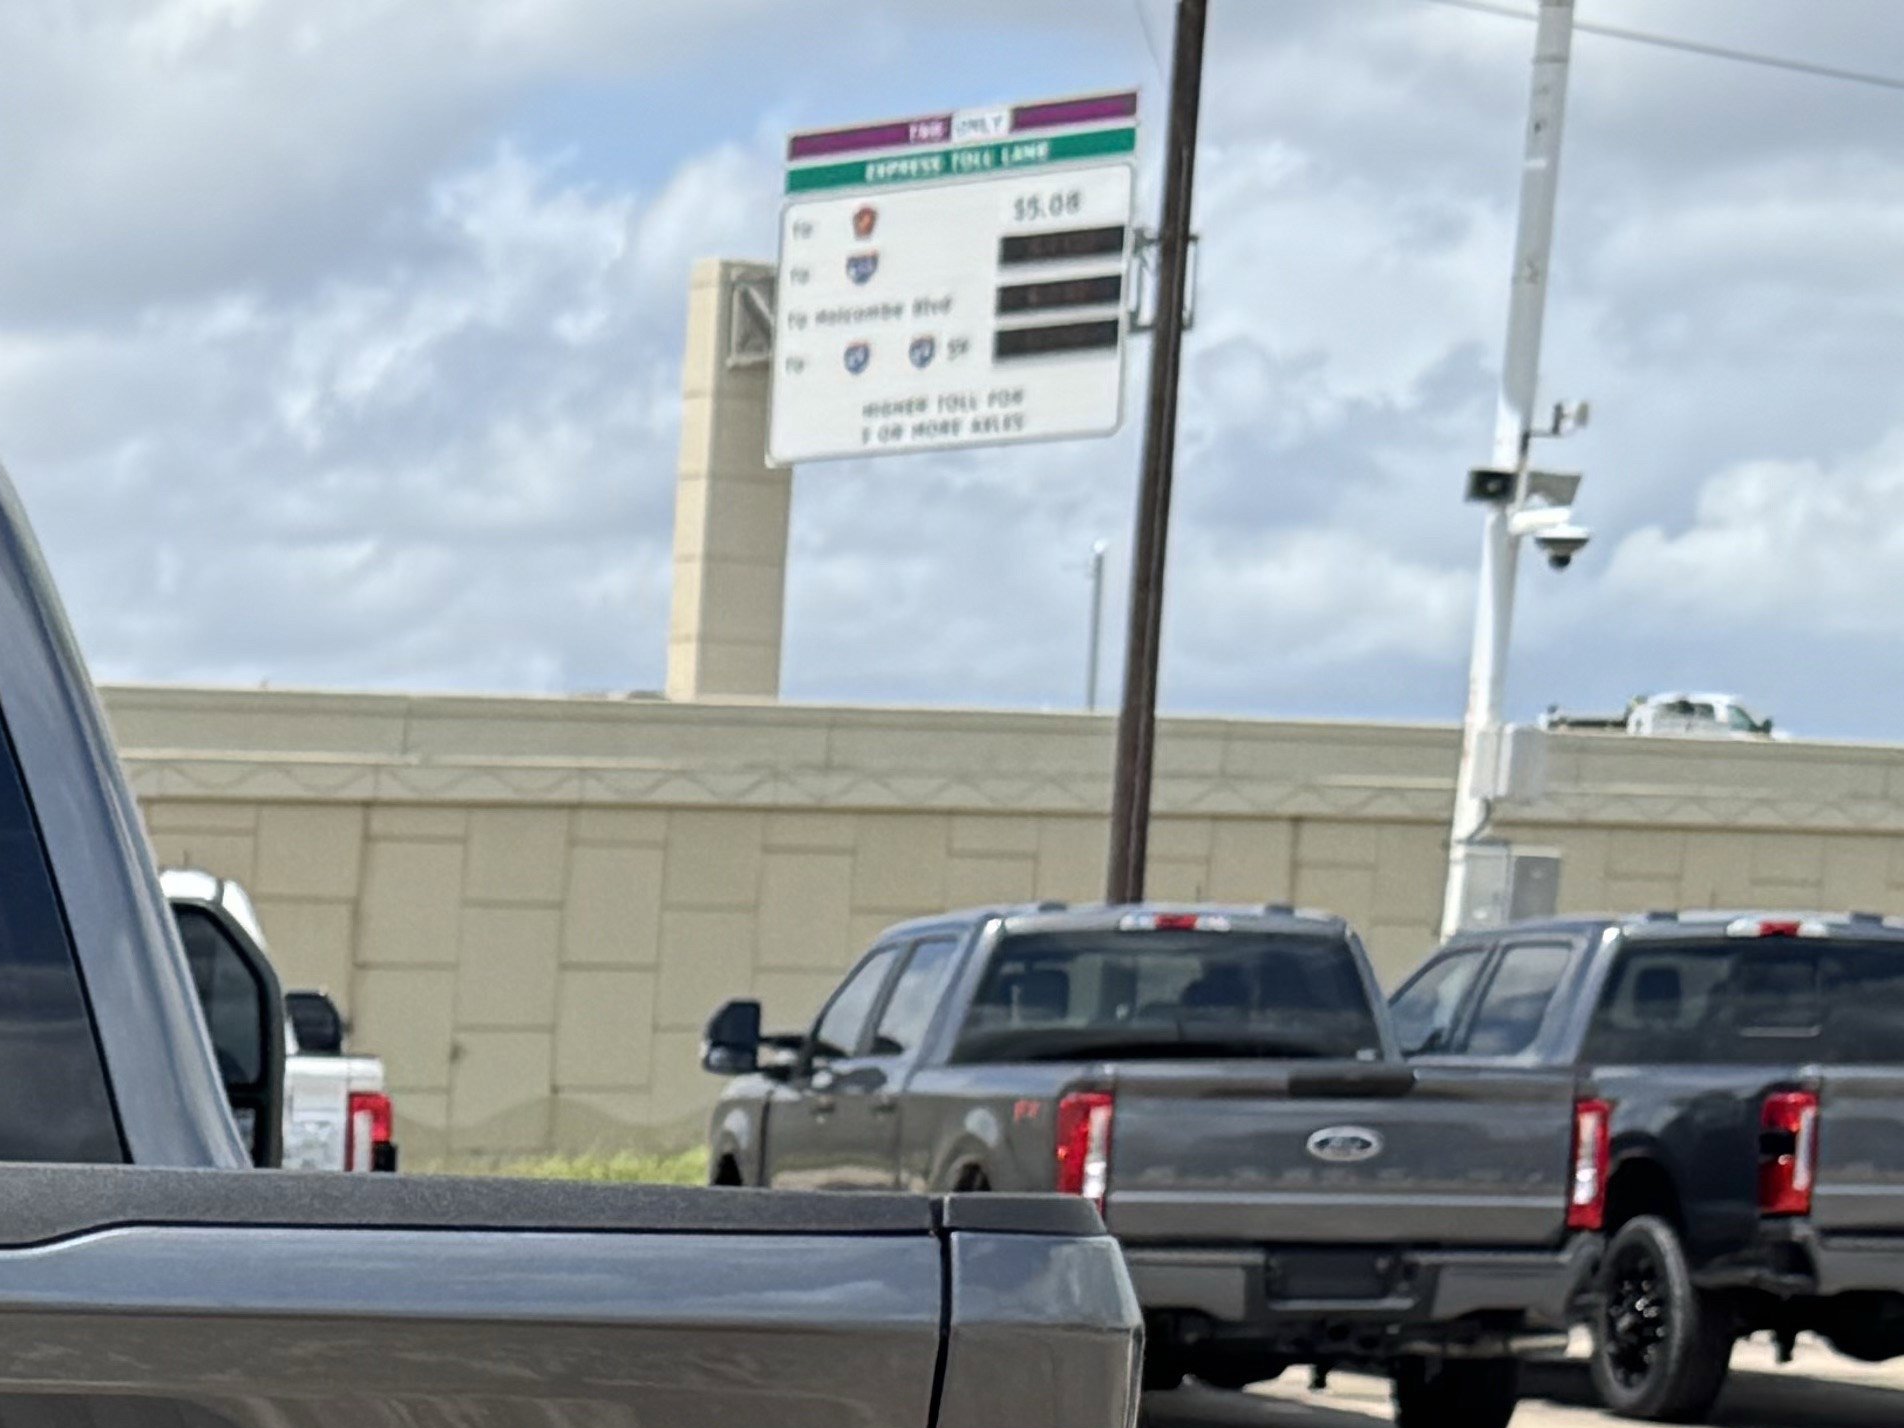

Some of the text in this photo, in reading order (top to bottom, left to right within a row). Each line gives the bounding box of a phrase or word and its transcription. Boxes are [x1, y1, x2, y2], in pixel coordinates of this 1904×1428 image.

[951, 149, 993, 171] TOLL
[1001, 141, 1050, 166] LANE
[937, 392, 977, 413] TOLL
[911, 417, 960, 438] MORE
[970, 412, 1024, 433] AXLES
